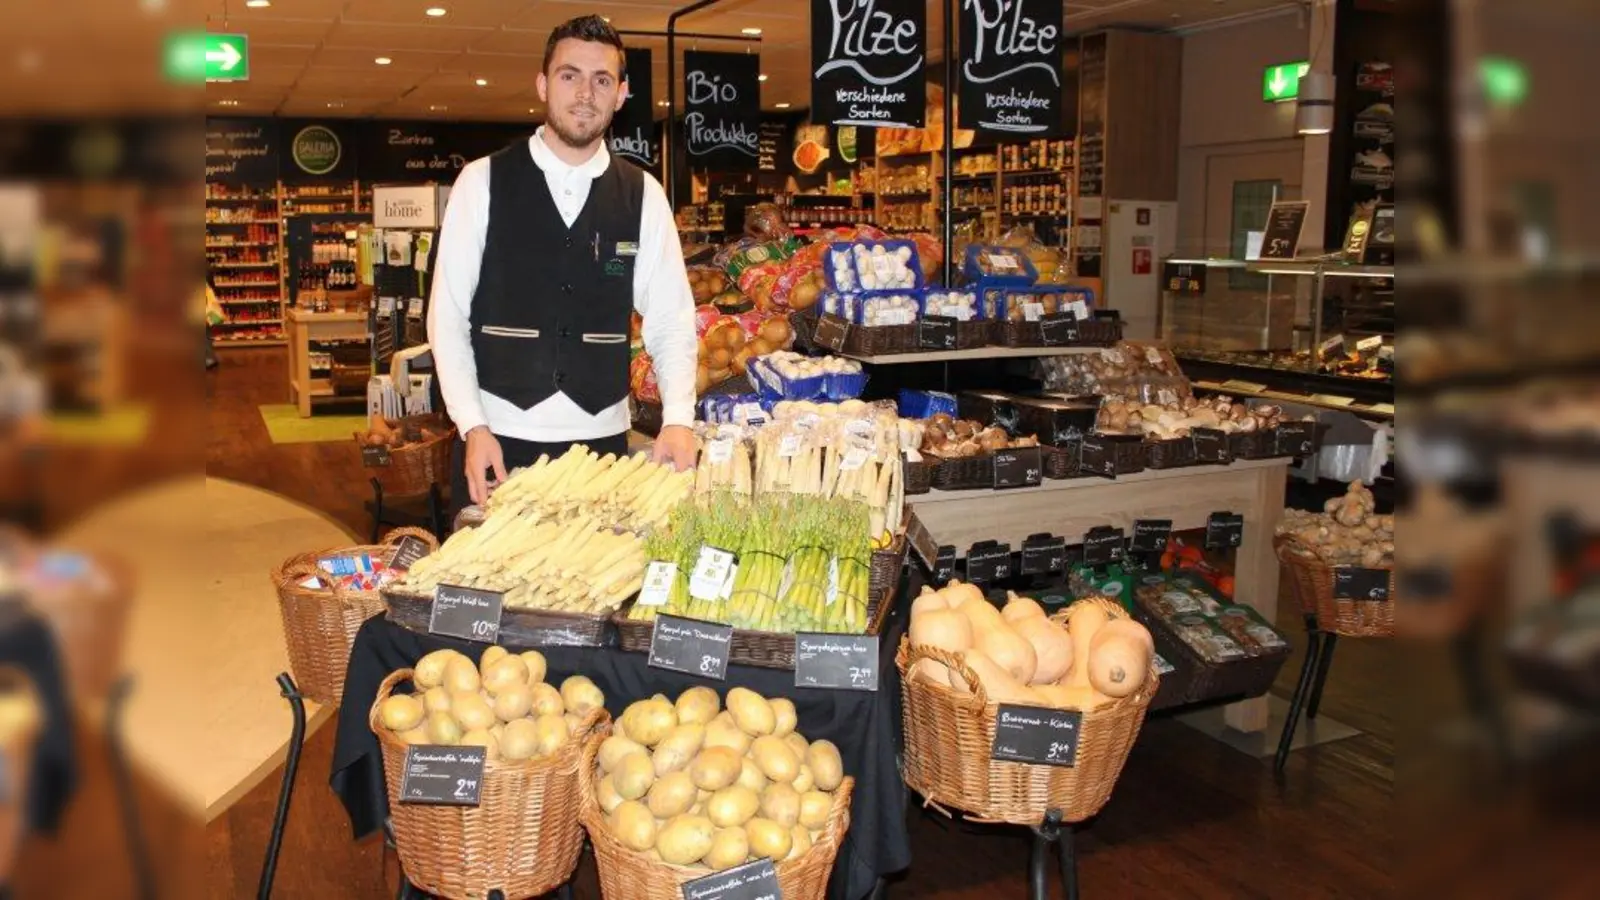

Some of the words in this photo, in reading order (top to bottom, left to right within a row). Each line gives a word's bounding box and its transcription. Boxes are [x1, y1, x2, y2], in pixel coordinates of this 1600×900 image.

[828, 0, 918, 60] Pilze
[964, 0, 1057, 64] Pilze
[687, 70, 737, 104] Bio
[848, 104, 891, 118] Sorten
[996, 110, 1032, 124] Sorten
[685, 112, 758, 149] Produkte
[384, 199, 422, 217] home
[849, 666, 872, 684] 7.99
[454, 779, 477, 797] 2.99
